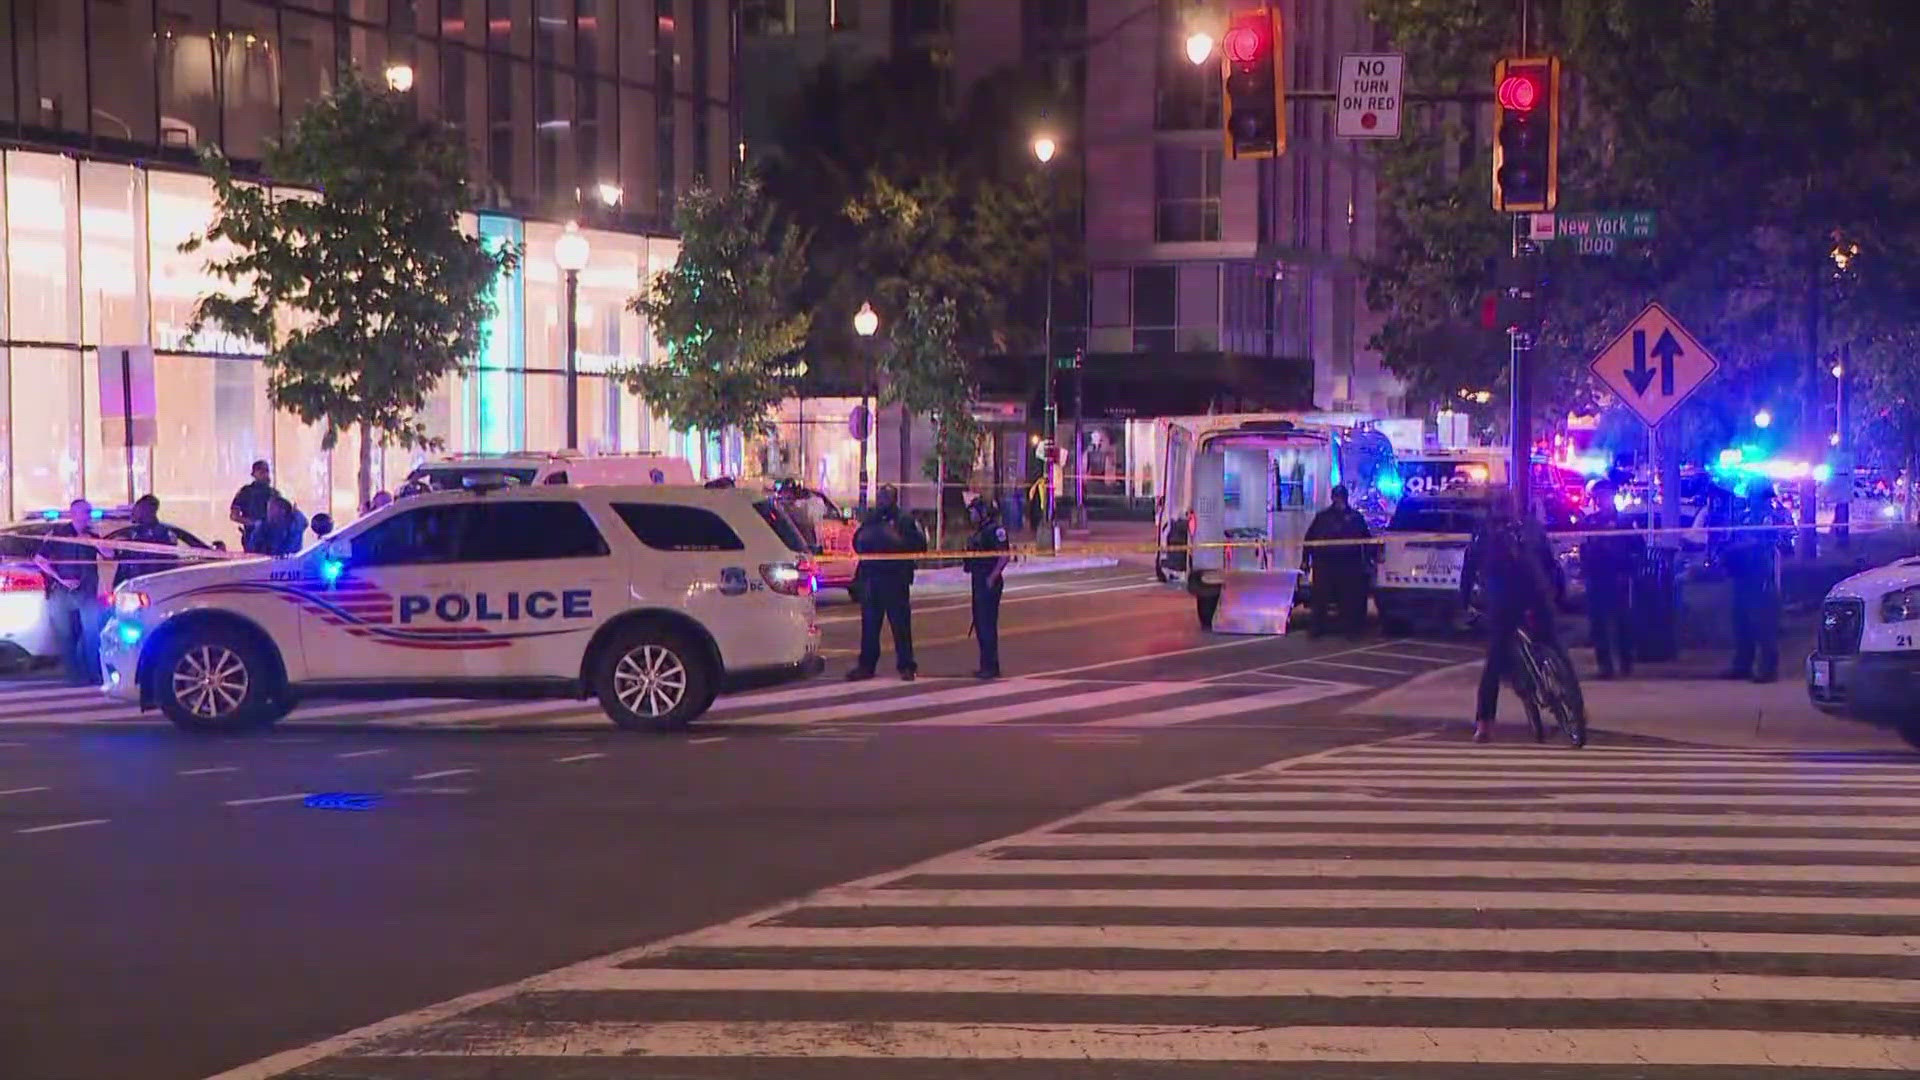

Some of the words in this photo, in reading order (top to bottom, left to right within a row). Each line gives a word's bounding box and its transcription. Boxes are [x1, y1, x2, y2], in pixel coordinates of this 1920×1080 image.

[1358, 61, 1385, 76] NO
[1354, 80, 1389, 93] TURN
[1343, 96, 1362, 110] ON
[1368, 97, 1395, 110] RED
[1558, 218, 1590, 236] New
[1595, 216, 1628, 235] York
[1633, 213, 1650, 223] Ave
[1633, 226, 1648, 236] NW
[1579, 237, 1614, 255] 1000
[399, 590, 593, 624] POLICE
[1896, 634, 1912, 647] 21
